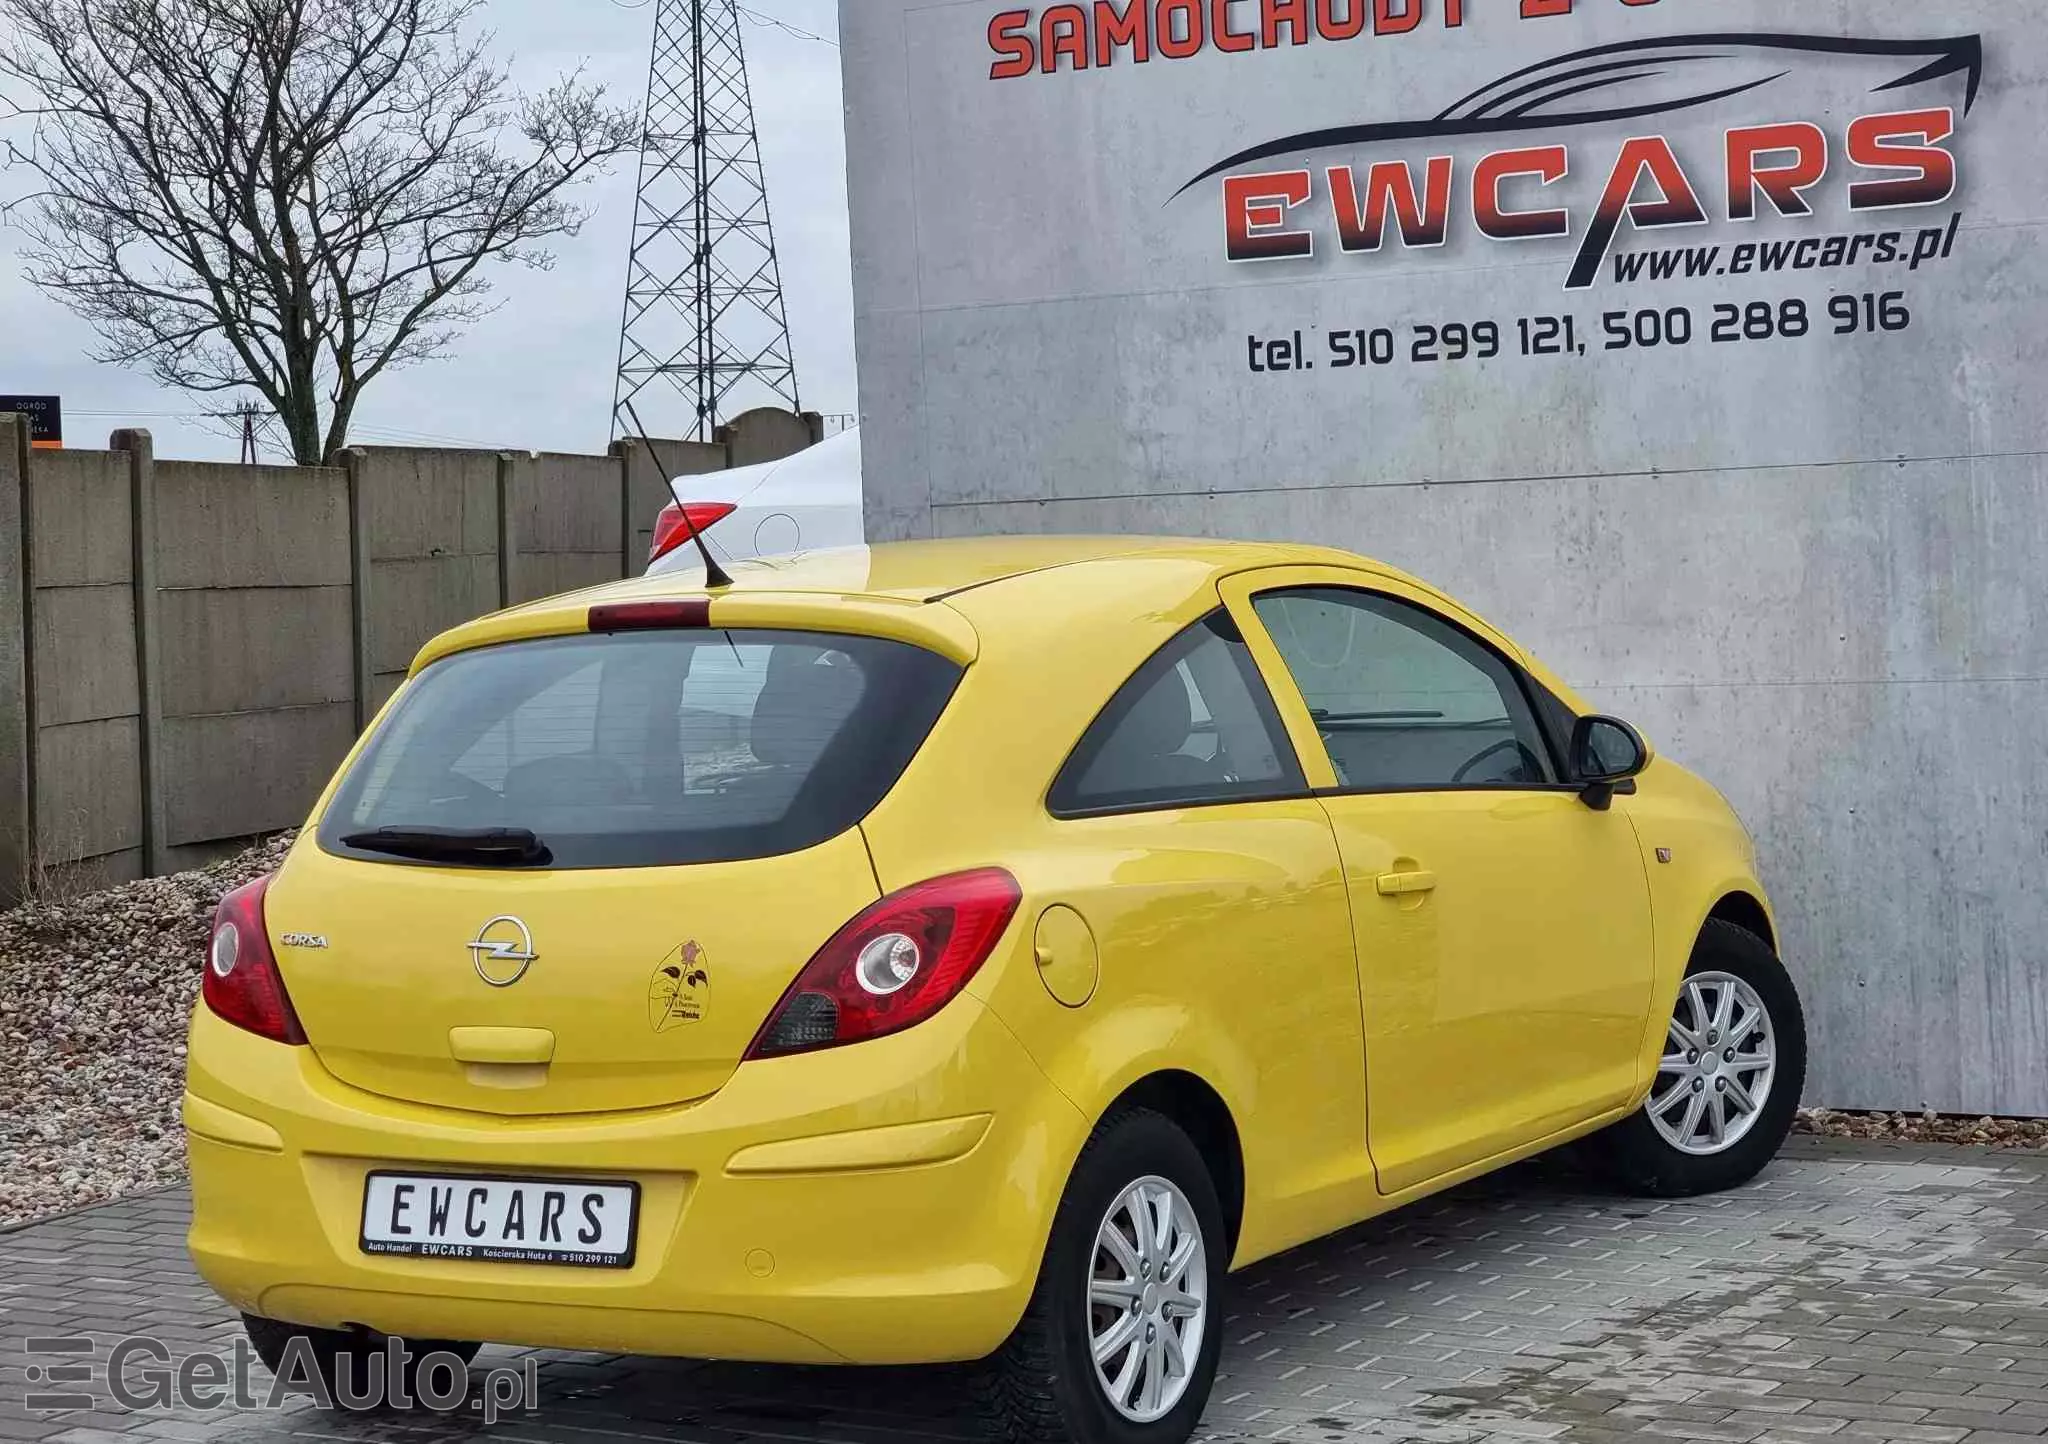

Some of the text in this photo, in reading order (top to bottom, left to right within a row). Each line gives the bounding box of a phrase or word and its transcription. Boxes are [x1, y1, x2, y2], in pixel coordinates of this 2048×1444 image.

[1222, 106, 1957, 291] EWCARS
[1614, 212, 1962, 284] www.ewcars.pl
[1247, 290, 1911, 372] tel. 510 299 121, 500 288 916
[280, 933, 328, 949] CORSA
[390, 1184, 605, 1245] EWCARS
[368, 1243, 385, 1251] Auto
[386, 1243, 412, 1253] Handel
[421, 1244, 473, 1256] EWCARS
[483, 1248, 525, 1259] Kościerska
[527, 1251, 545, 1260] Huta
[569, 1253, 583, 1262] 510
[585, 1254, 601, 1263] 299
[604, 1255, 617, 1264] 121
